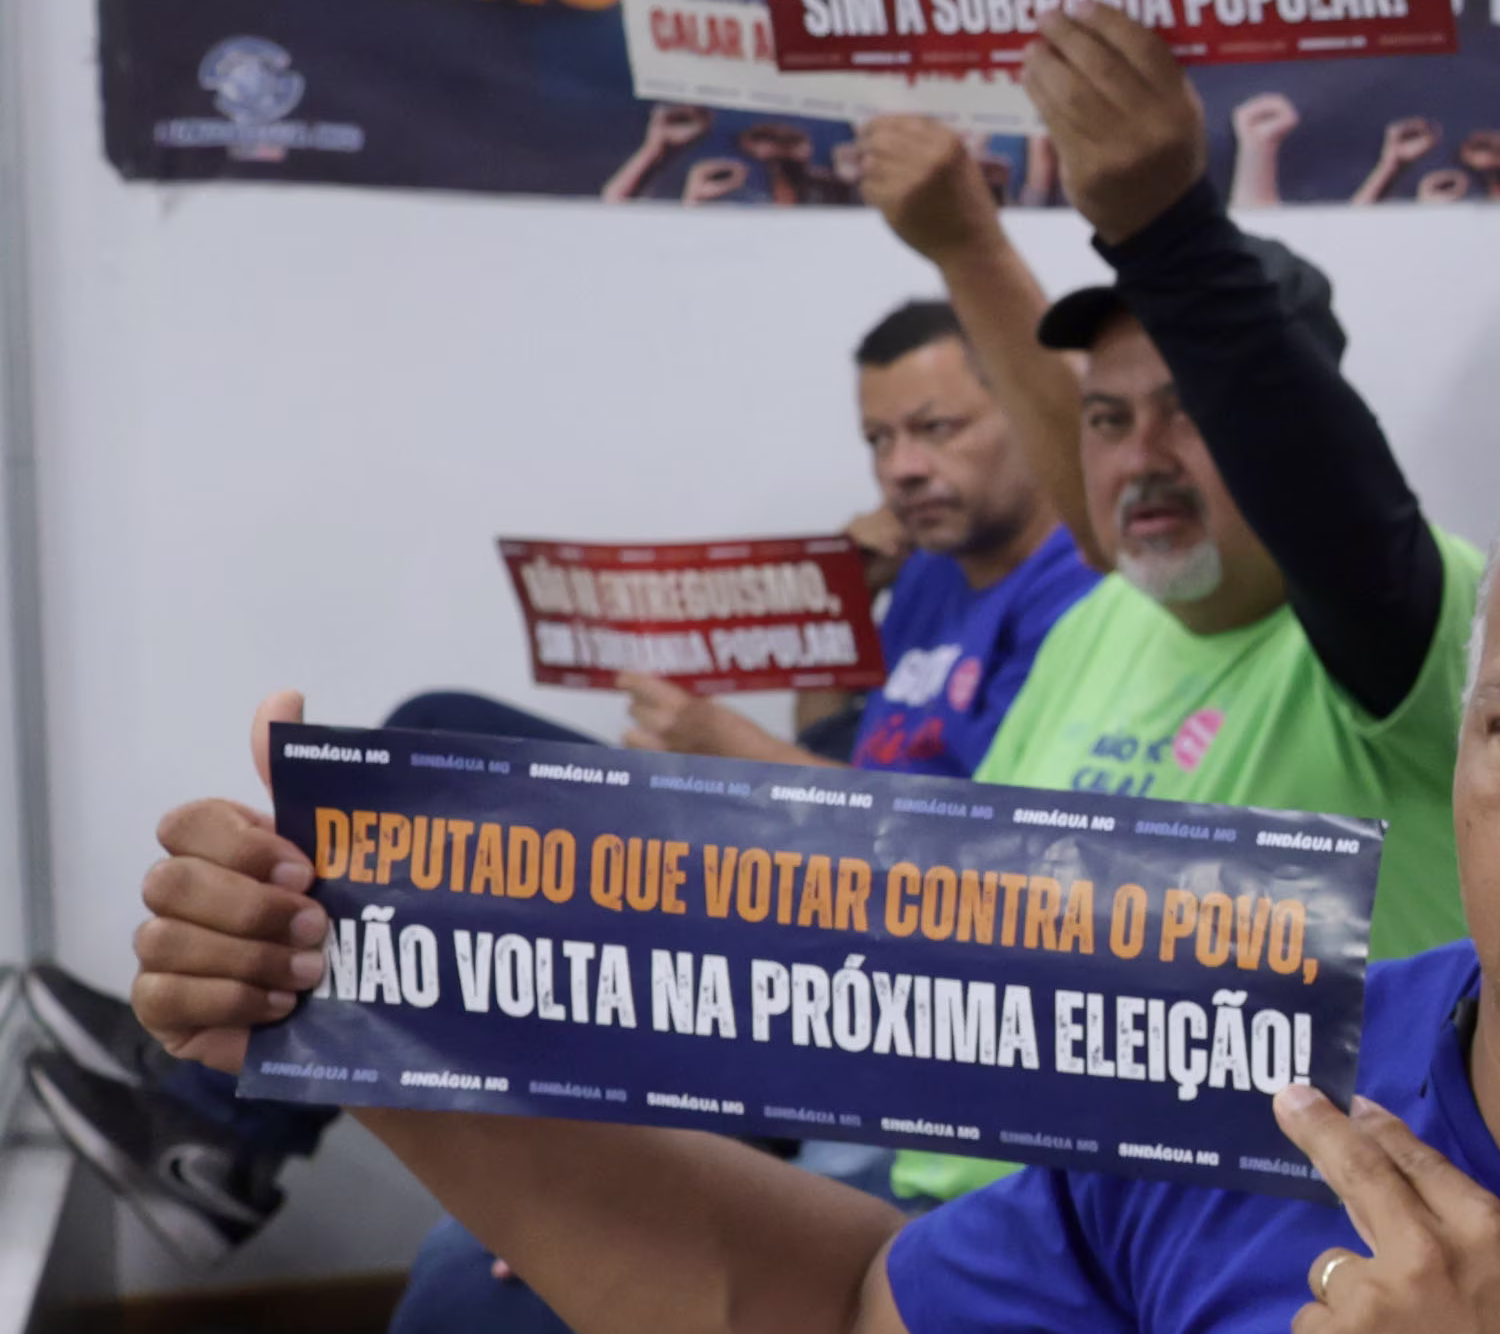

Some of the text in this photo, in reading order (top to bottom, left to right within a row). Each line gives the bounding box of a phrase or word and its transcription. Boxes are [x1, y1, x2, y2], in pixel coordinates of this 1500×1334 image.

[284, 744, 389, 763] SINDÁGUA MG
[530, 763, 630, 785] SINDÁGUA MG
[1014, 809, 1115, 831] SINDÁGUA MG
[1257, 831, 1359, 854] SINDÁGUA MG
[314, 806, 1319, 984] DEPUTADO QUE VOTAR CONTRA O POVO,
[319, 905, 1312, 1100] NÃO VOLTA NA PRÓXIMA ELEIÇÃO!
